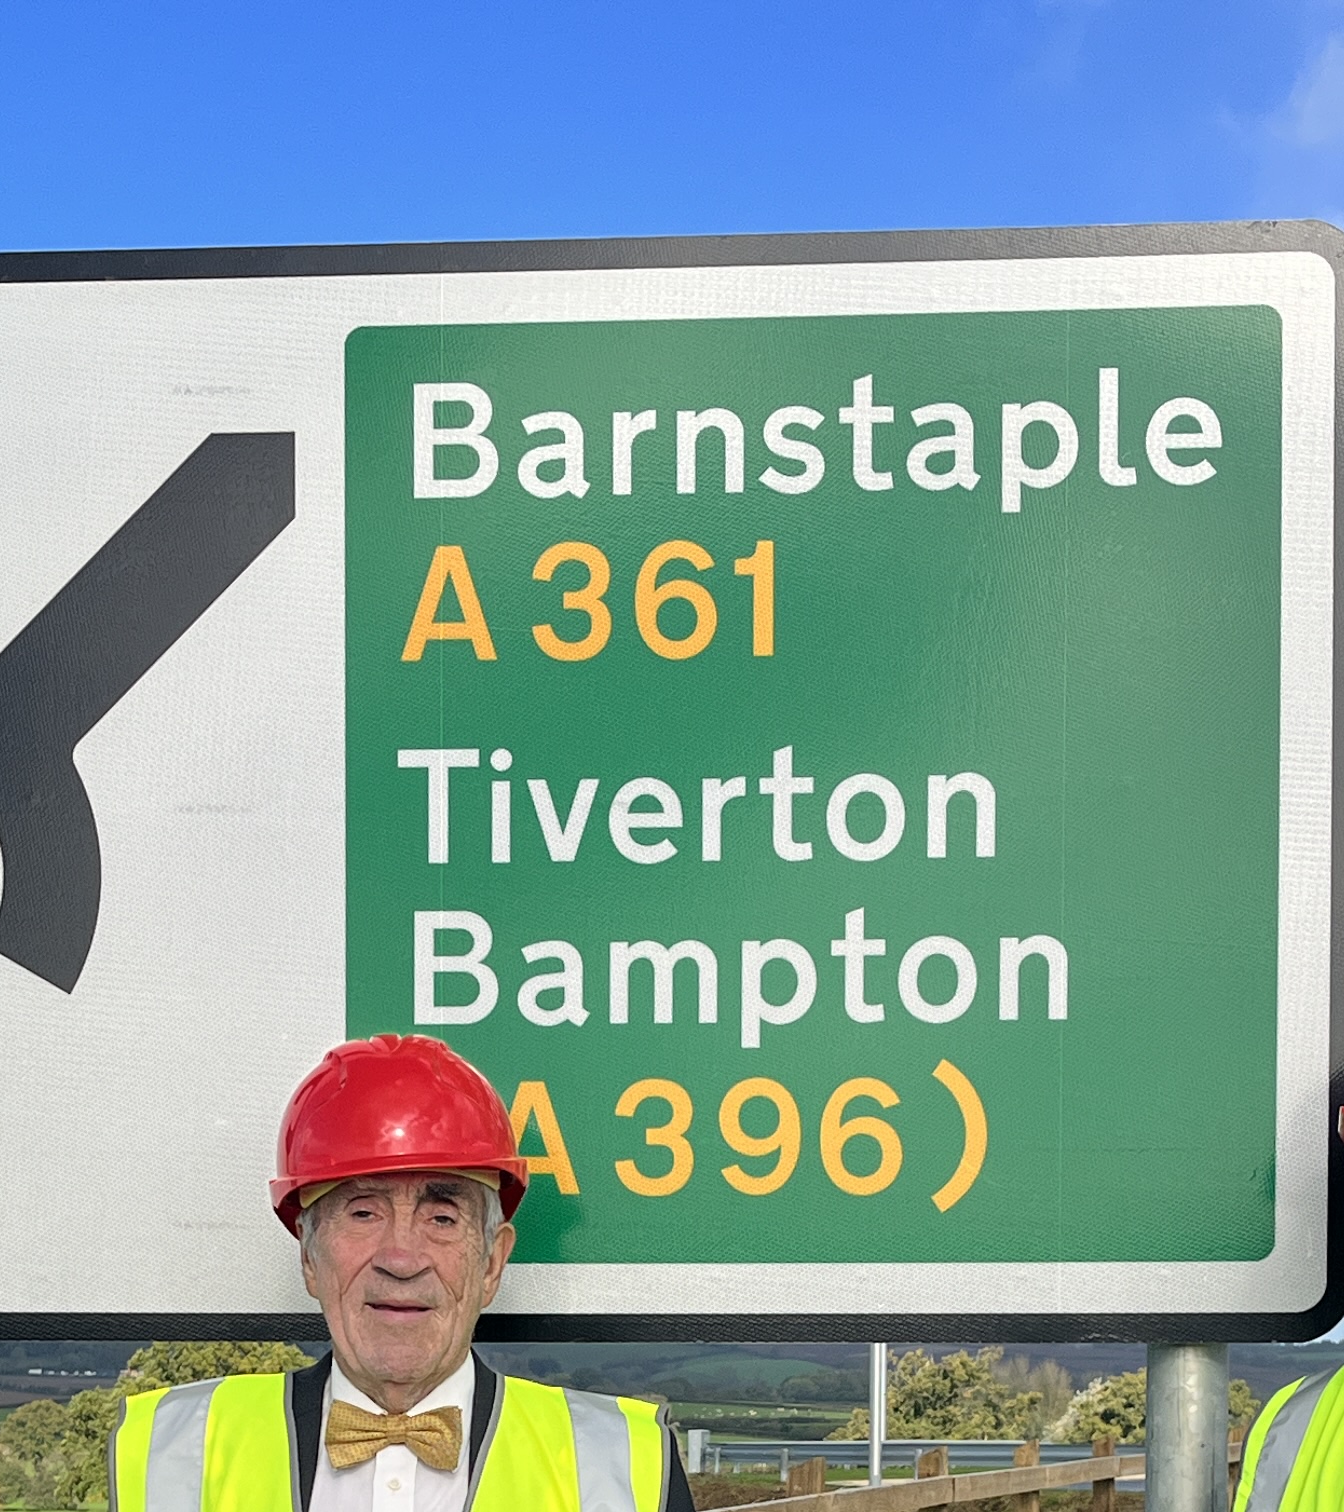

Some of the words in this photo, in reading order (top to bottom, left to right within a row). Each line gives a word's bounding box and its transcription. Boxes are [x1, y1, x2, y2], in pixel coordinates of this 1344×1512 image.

[413, 367, 1223, 513] Barnstaple
[397, 745, 996, 865] Tiverton
[413, 907, 1069, 1049] Bampton
